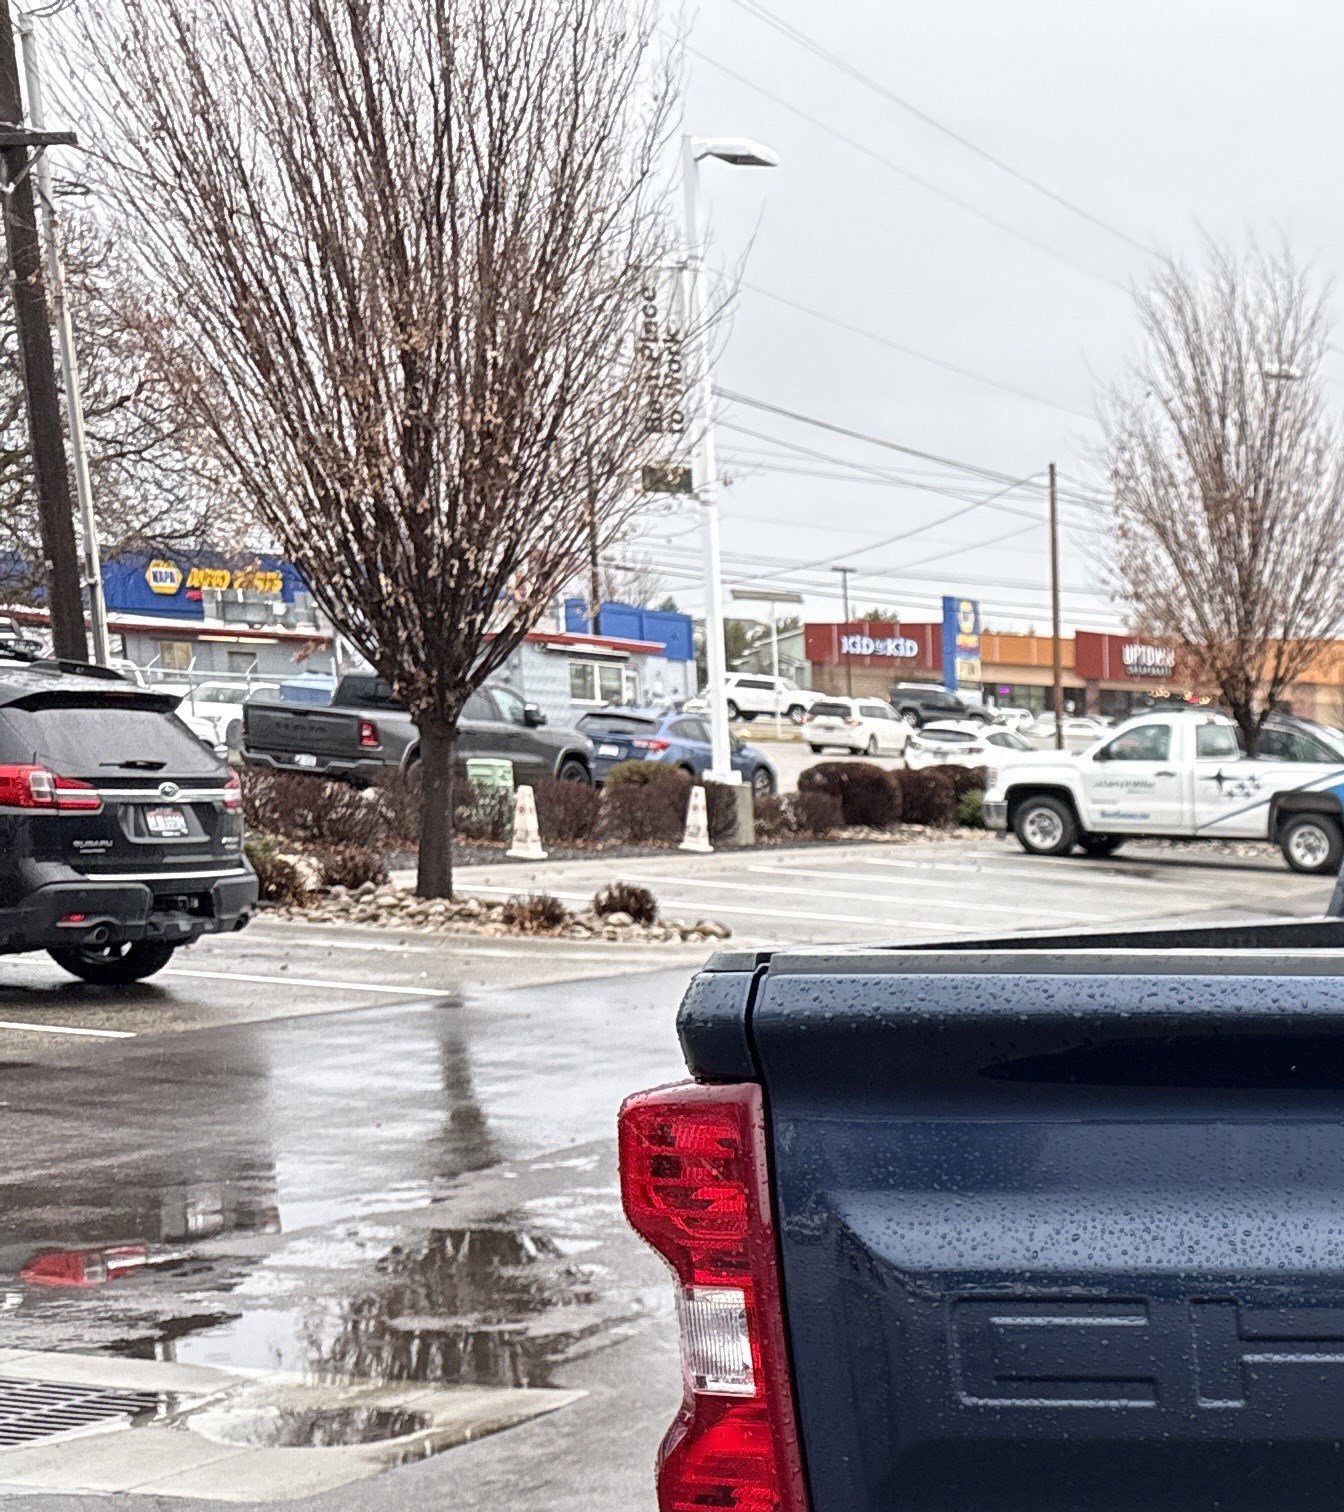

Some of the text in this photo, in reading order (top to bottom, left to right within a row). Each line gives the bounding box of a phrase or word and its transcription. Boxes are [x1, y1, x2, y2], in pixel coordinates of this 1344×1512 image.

[152, 570, 176, 584] NAPA
[186, 567, 231, 589] AUTO
[886, 637, 919, 658] KID
